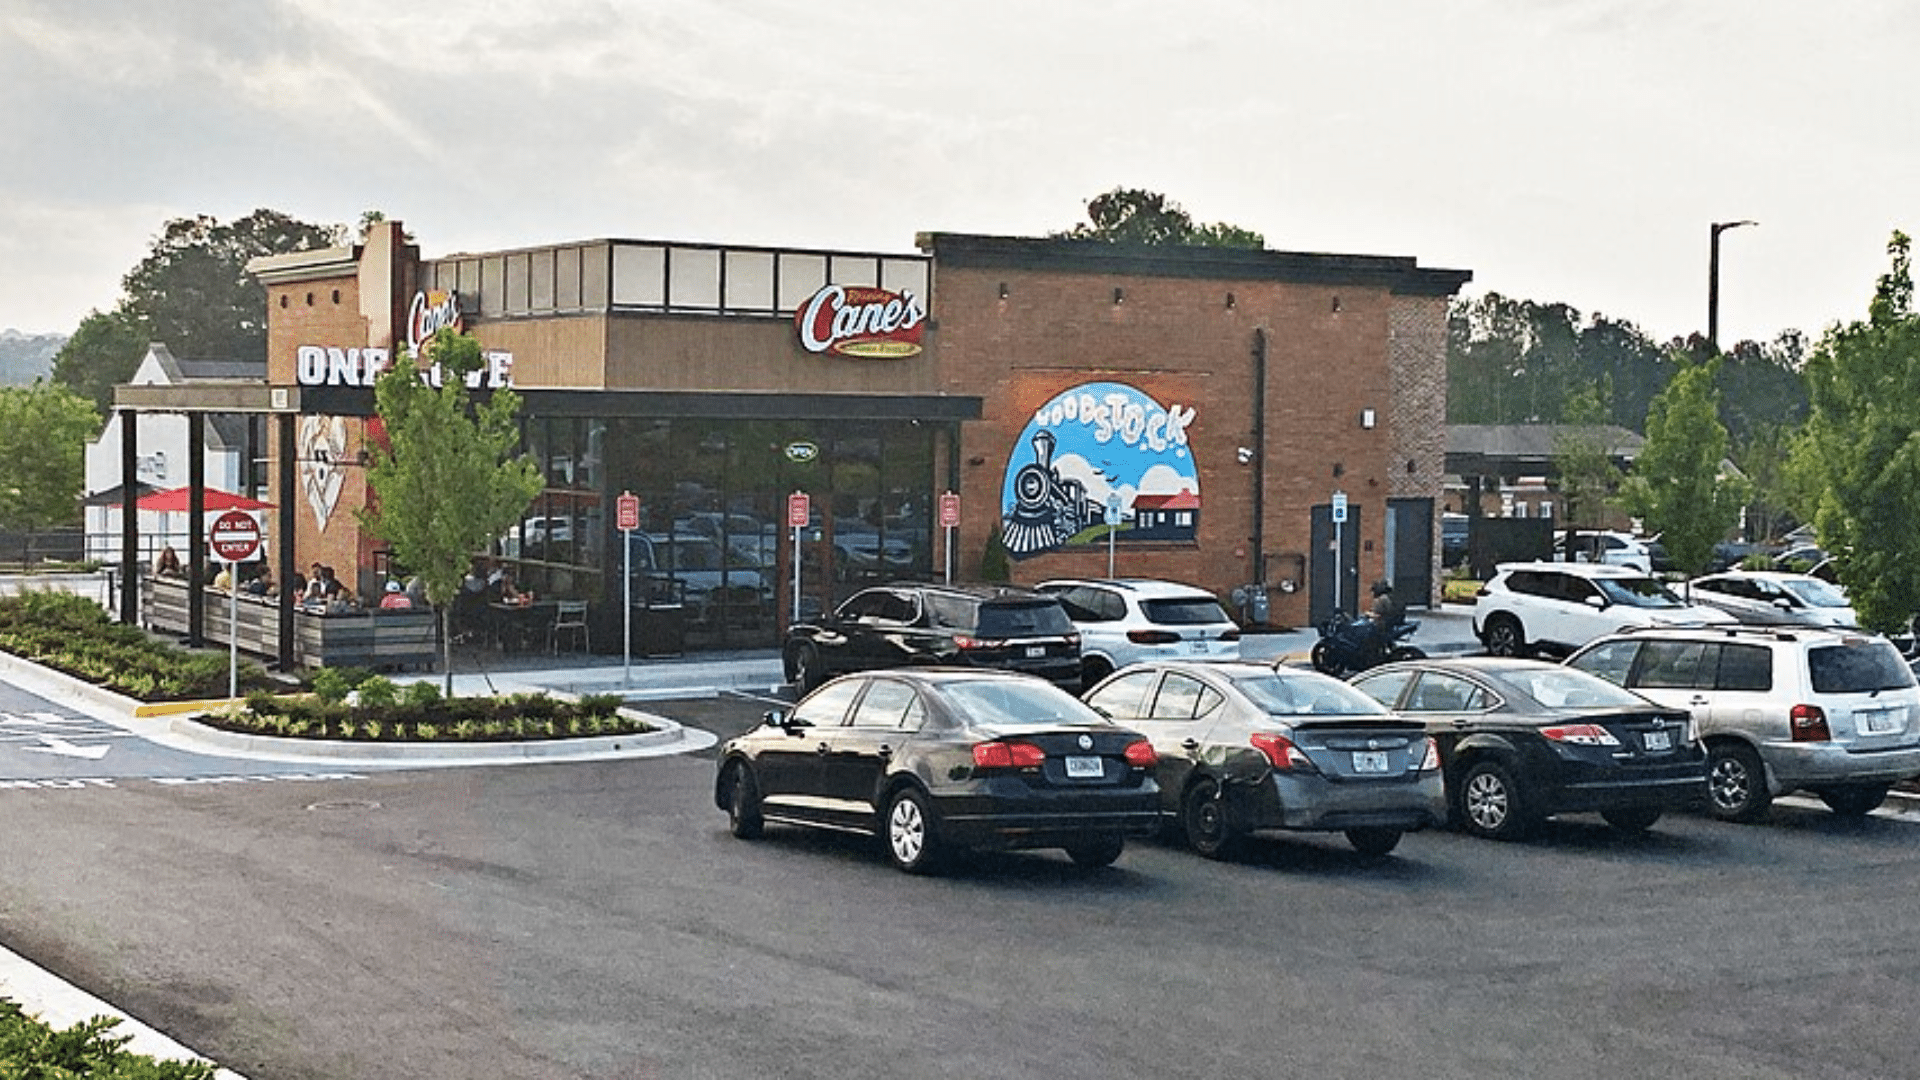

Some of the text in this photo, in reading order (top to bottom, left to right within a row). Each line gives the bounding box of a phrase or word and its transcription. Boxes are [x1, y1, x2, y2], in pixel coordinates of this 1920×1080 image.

[802, 284, 926, 352] Cane's
[1035, 393, 1197, 452] WOODSTOCK
[219, 520, 252, 529] DO NOT
[221, 544, 250, 552] ENTER
